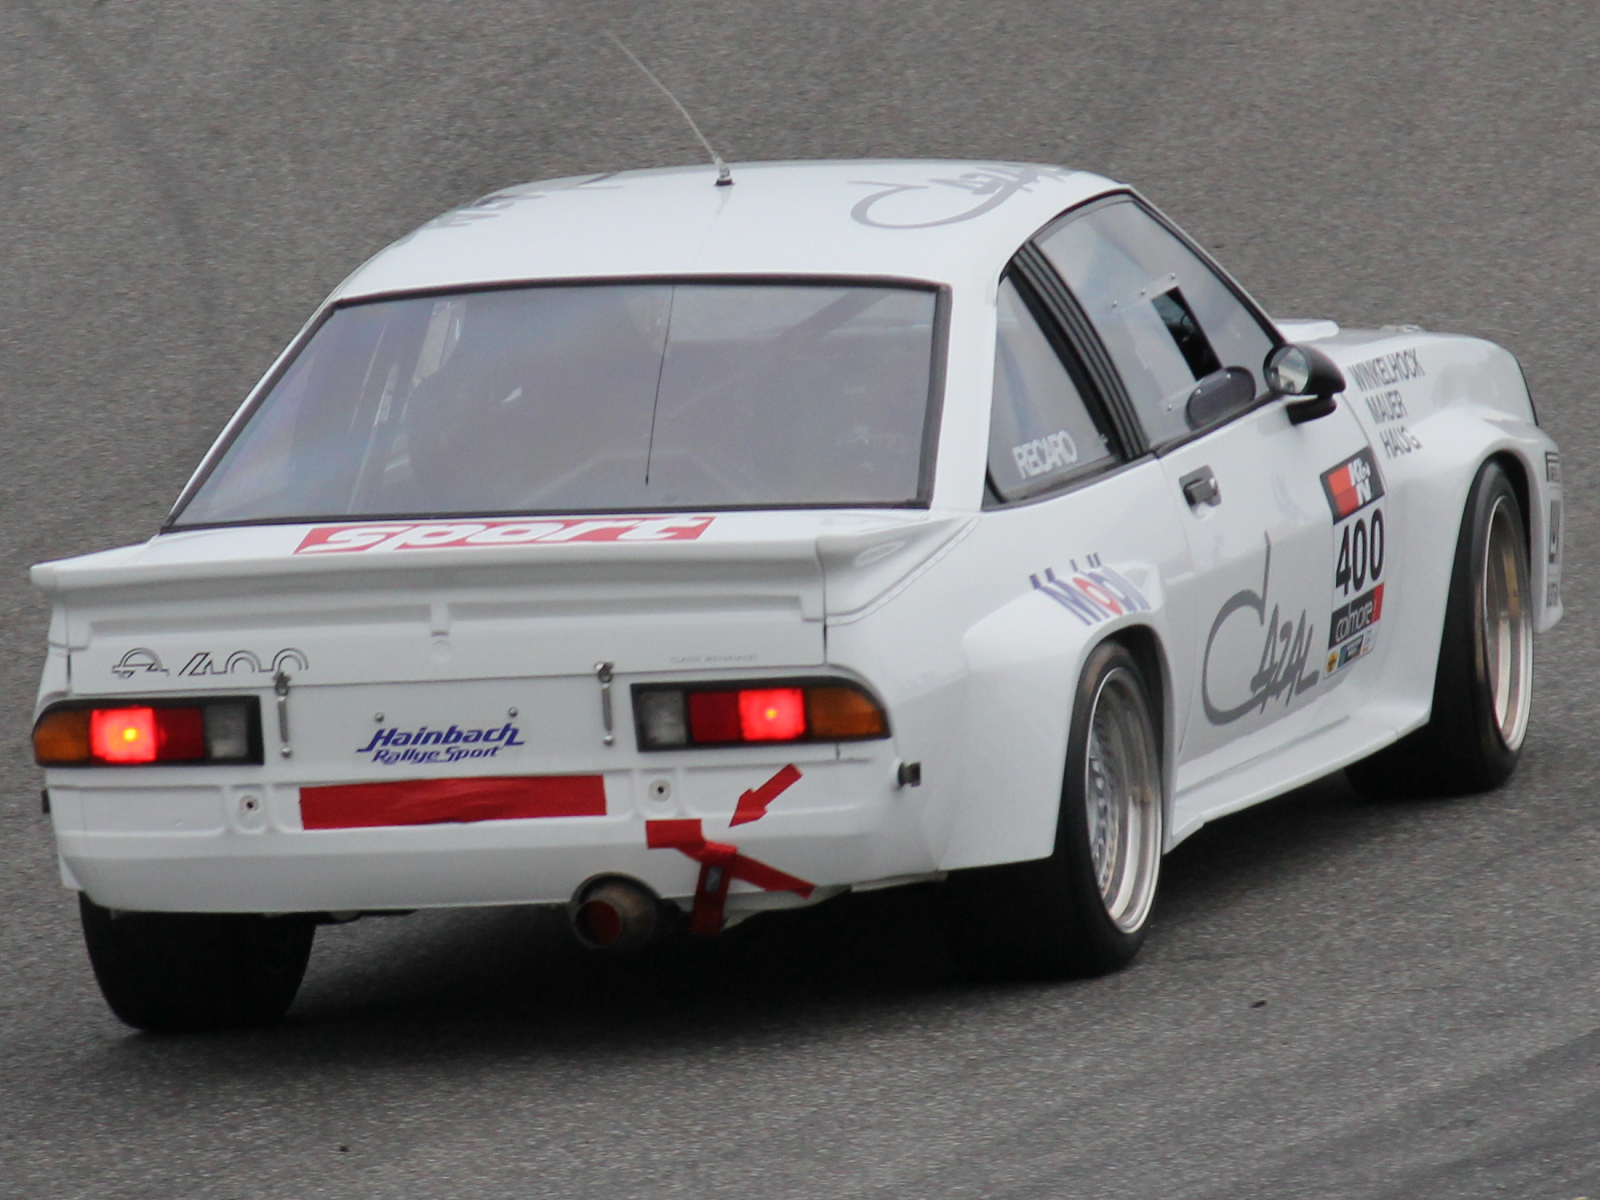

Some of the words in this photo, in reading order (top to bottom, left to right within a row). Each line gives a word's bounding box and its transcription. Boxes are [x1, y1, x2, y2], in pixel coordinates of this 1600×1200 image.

[1348, 348, 1425, 392] WINKELHOCK
[1366, 390, 1408, 424] MAUER
[1012, 429, 1078, 480] RECARO
[303, 516, 712, 553] sport
[1335, 508, 1384, 596] 400
[1335, 600, 1373, 644] colmore
[355, 722, 525, 753] Hainbach
[371, 748, 440, 766] Rallye
[445, 745, 501, 763] Sport
